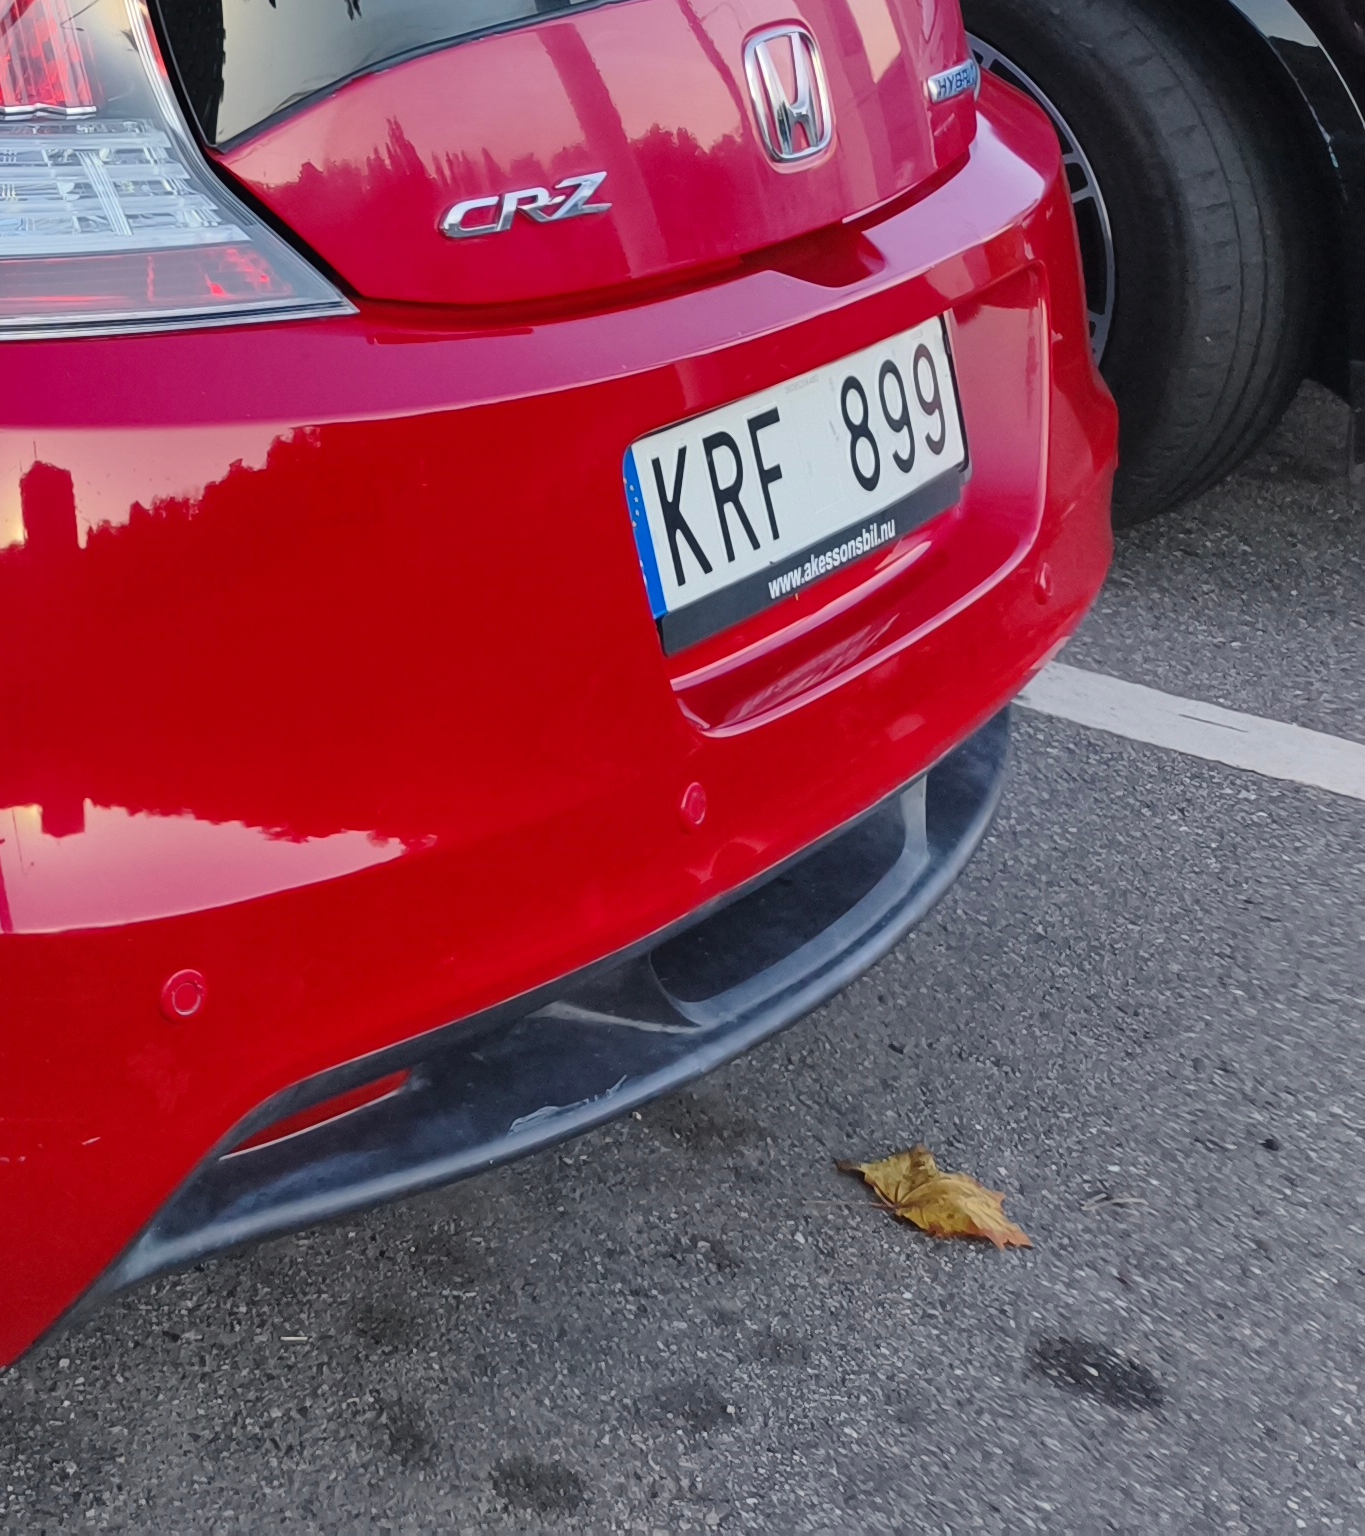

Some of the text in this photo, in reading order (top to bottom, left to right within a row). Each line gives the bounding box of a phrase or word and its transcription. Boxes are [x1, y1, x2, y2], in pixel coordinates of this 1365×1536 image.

[936, 63, 975, 96] HYBR
[651, 343, 946, 586] KRF 899
[768, 519, 896, 599] www.akessonsbil.nu
